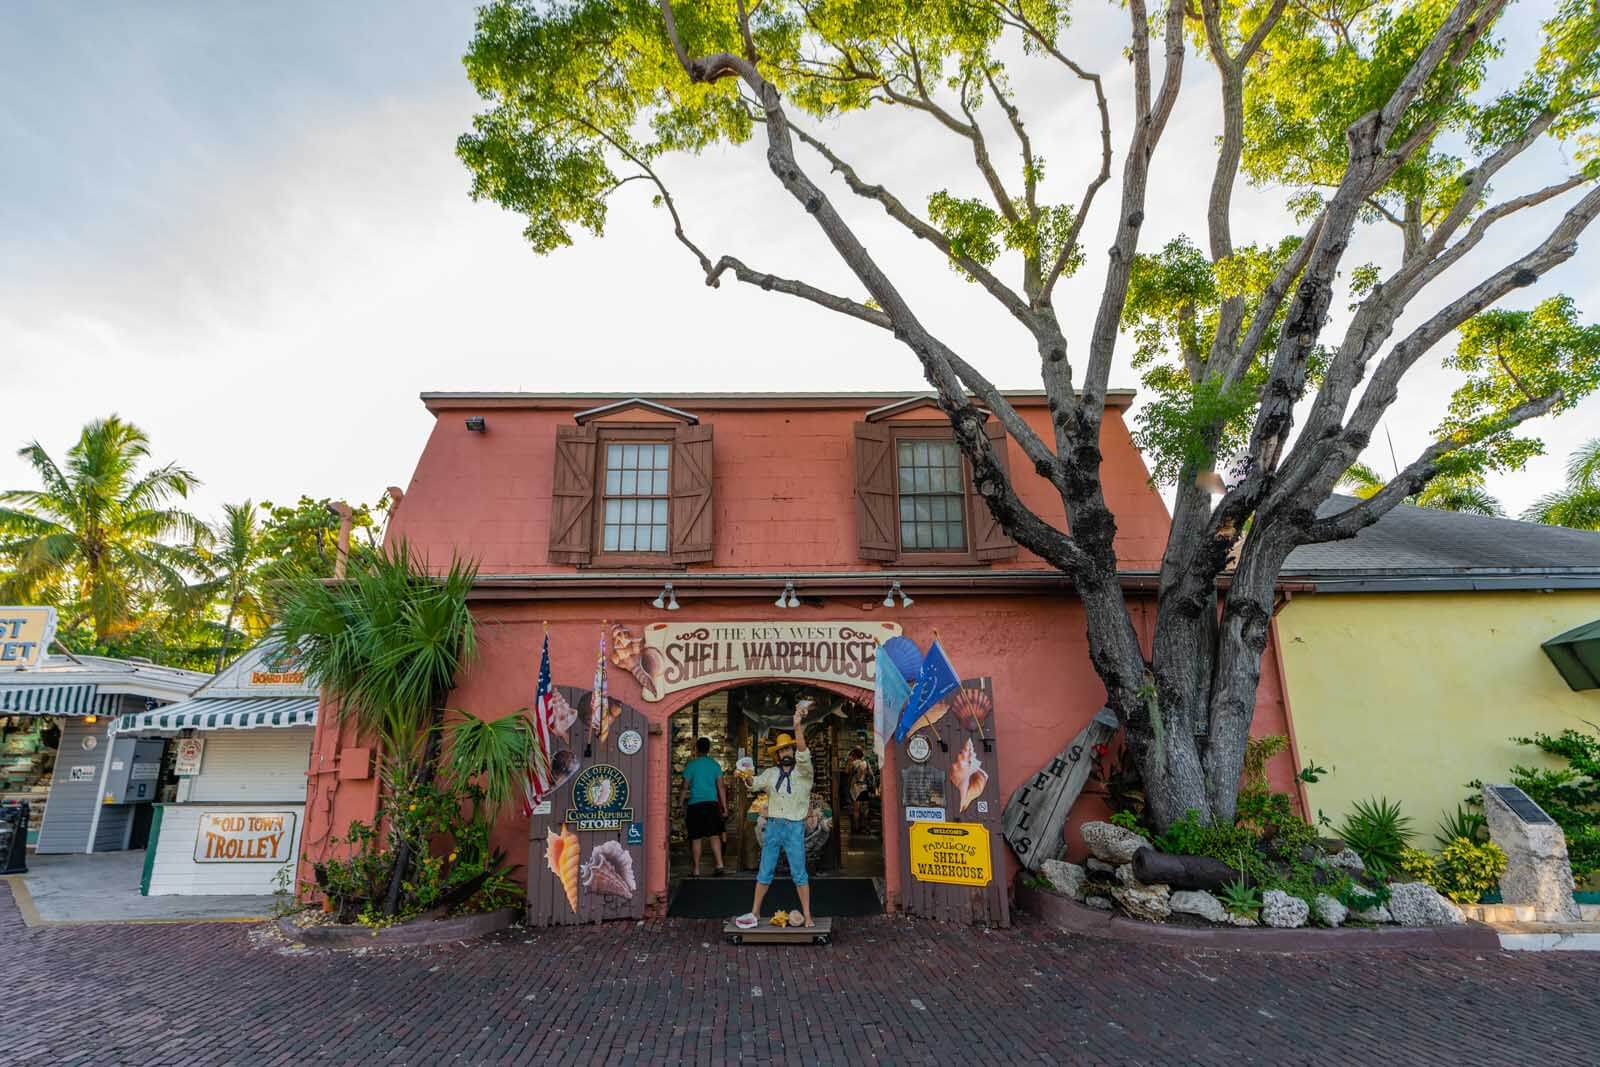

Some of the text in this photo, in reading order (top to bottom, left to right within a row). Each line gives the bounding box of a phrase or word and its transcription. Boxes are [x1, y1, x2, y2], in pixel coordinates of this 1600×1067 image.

[712, 626, 836, 641] THE KEY WEST
[0, 641, 37, 660] ET
[664, 640, 877, 684] SHELL WAREHOUSE
[252, 671, 282, 684] BOARD
[577, 766, 625, 786] THE OFFICIAL
[1015, 745, 1083, 854] SHELLS
[222, 815, 245, 832] OLD
[247, 815, 284, 832] TOWN
[580, 819, 619, 829] STORE
[205, 831, 285, 858] TROLLEY
[933, 851, 967, 865] SHELL
[918, 863, 984, 879] WAREHOUSE
